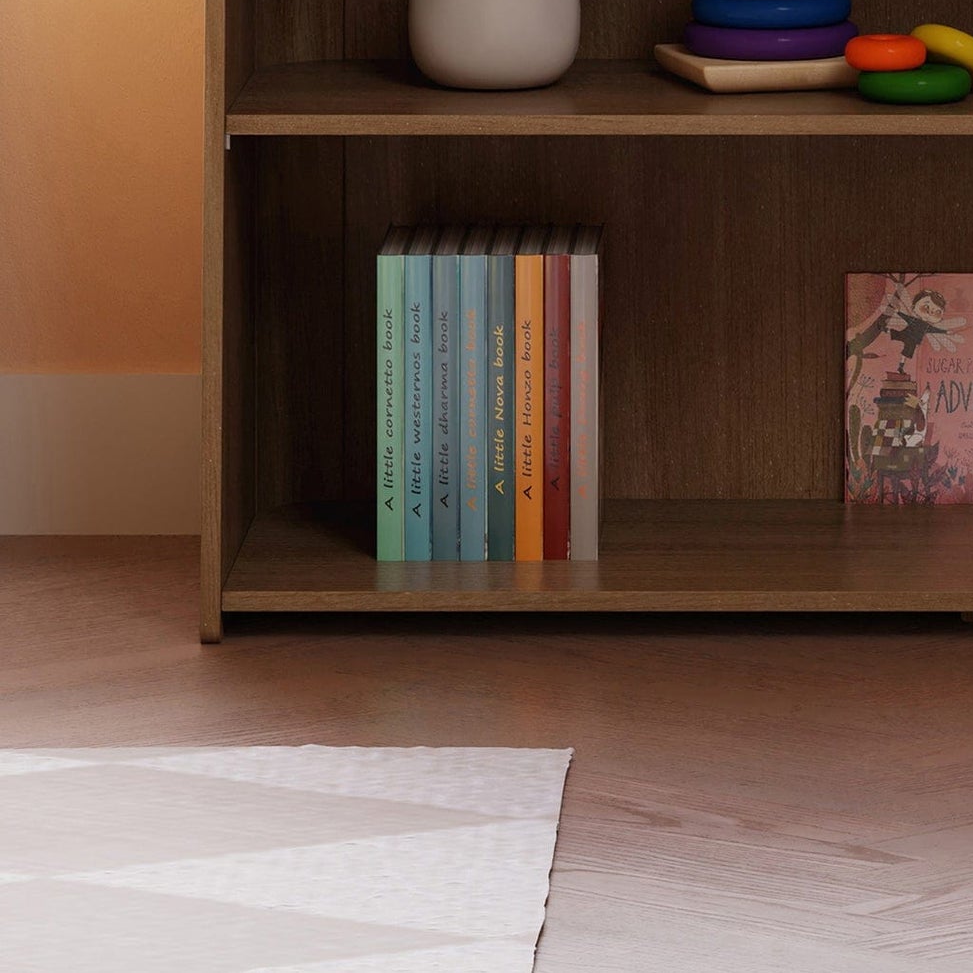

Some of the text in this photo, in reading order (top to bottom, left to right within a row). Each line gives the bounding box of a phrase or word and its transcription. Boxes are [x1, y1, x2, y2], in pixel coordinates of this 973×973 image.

[382, 307, 394, 511] A little cornetto book
[411, 301, 421, 518] A little westernos book
[438, 310, 449, 508] A little dharma book
[493, 325, 505, 494] A little Nova book
[522, 320, 532, 499] A little Honzo book
[926, 358, 965, 374] SUGAR
[466, 445, 477, 489] little
[467, 496, 477, 511] A
[551, 477, 560, 491] A
